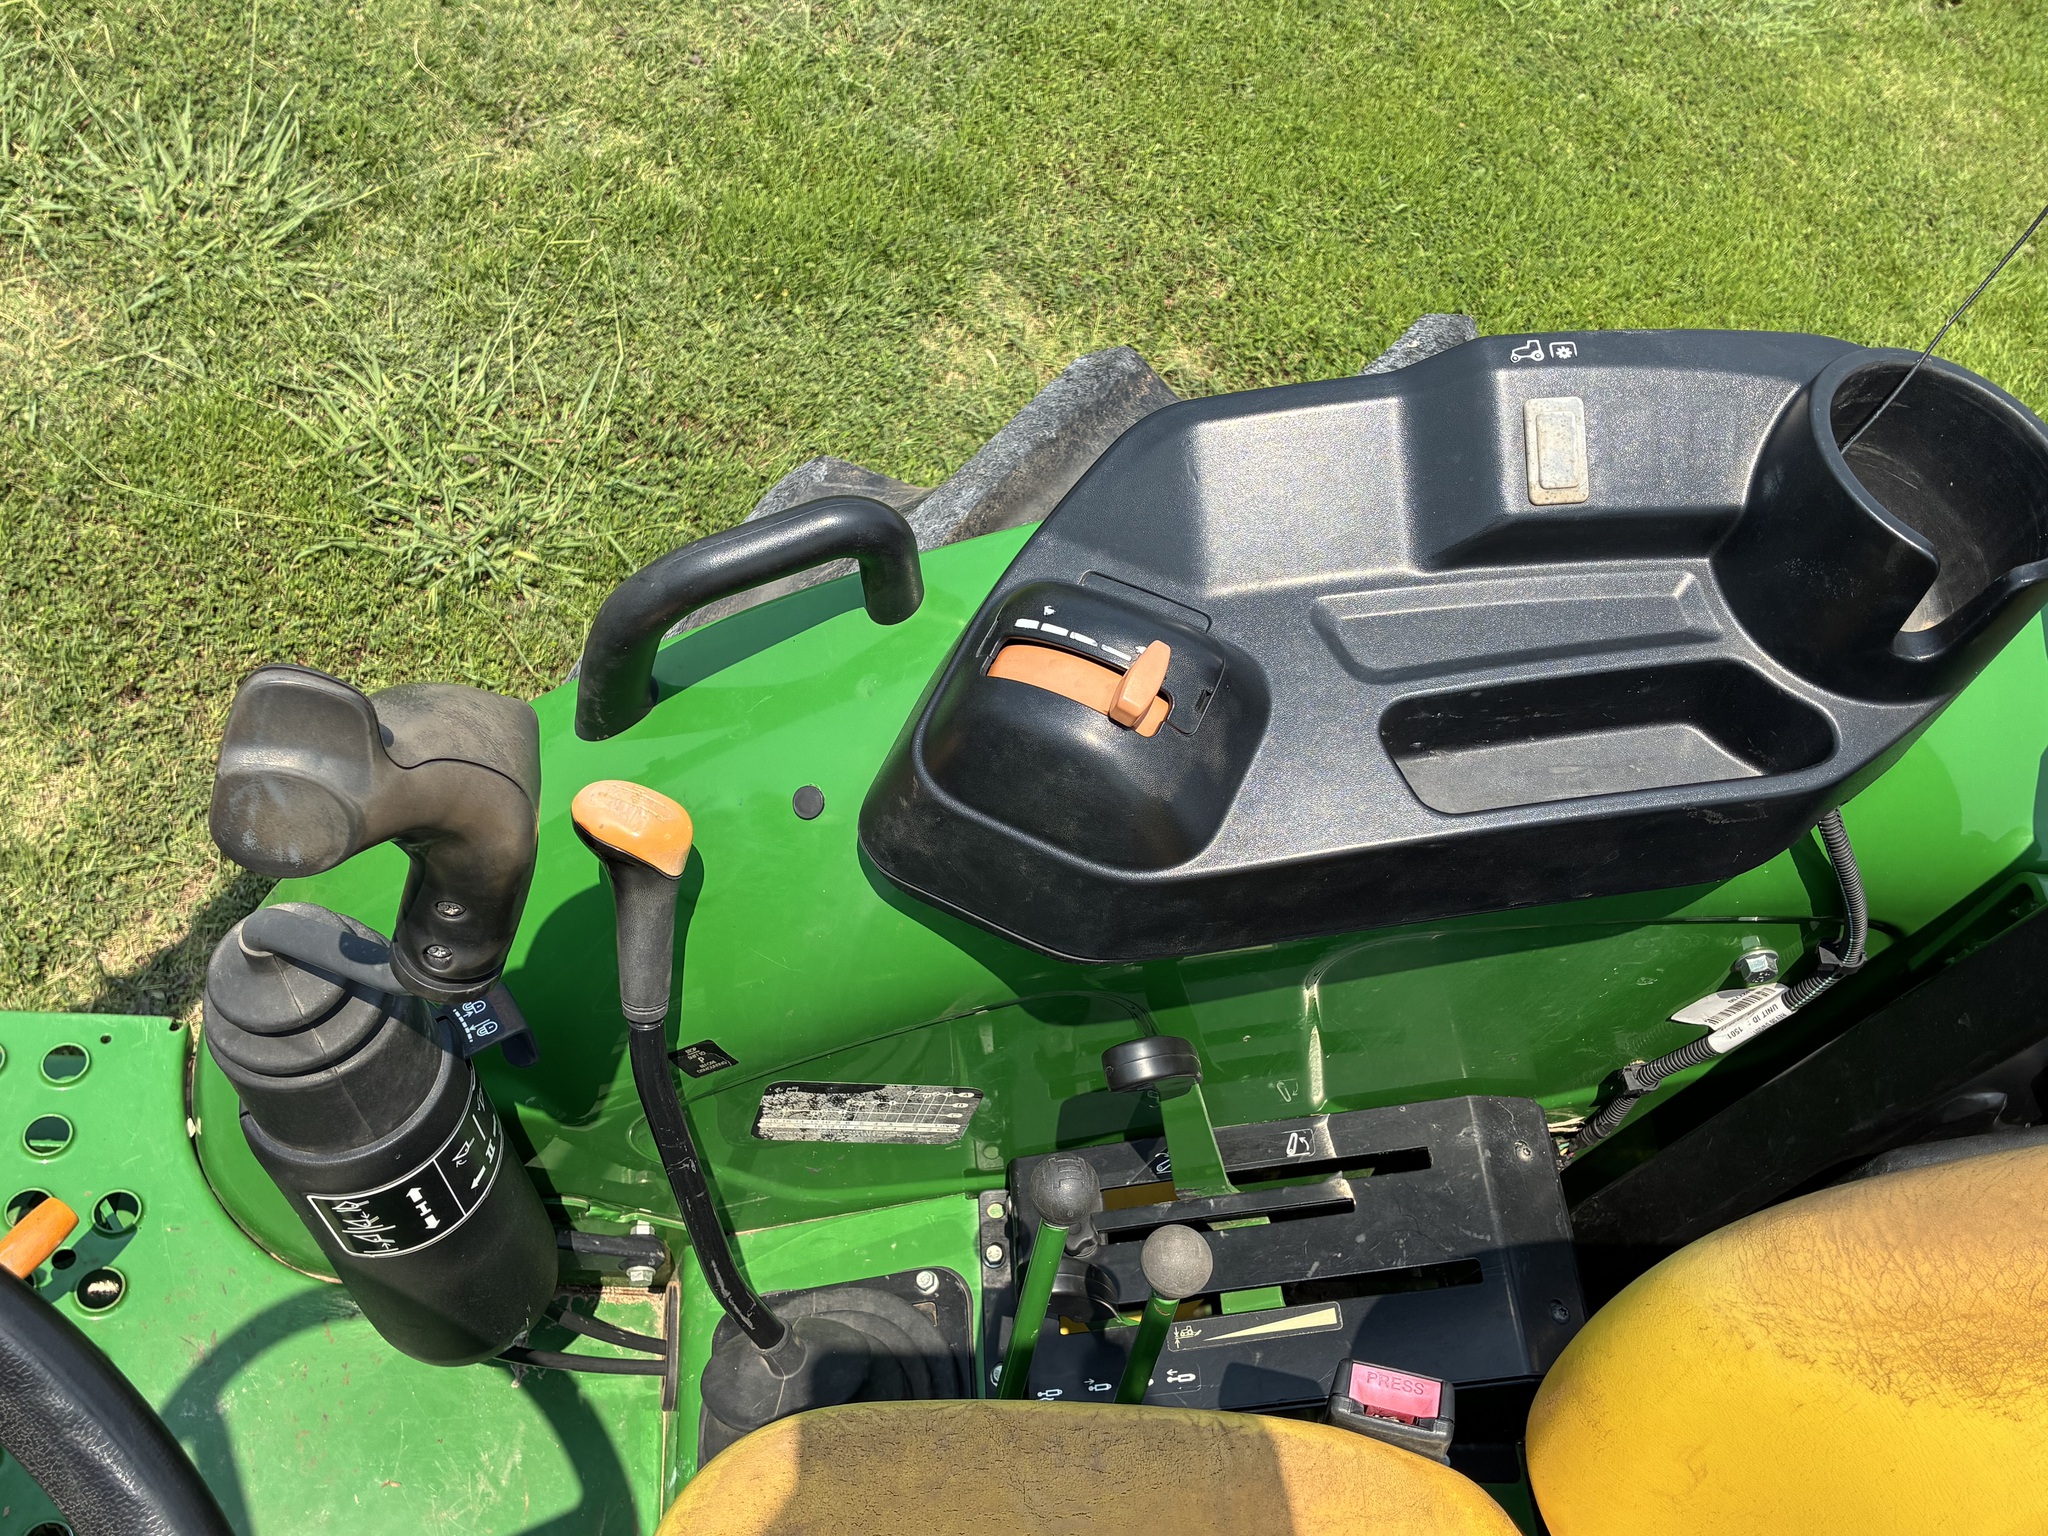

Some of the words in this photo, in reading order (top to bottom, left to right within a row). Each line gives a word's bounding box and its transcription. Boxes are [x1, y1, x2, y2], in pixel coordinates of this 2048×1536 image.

[1762, 1003, 1779, 1018] UNIT
[1752, 1015, 1761, 1024] ID
[1726, 1026, 1744, 1040] 1501
[1366, 1371, 1425, 1395] PRESS
